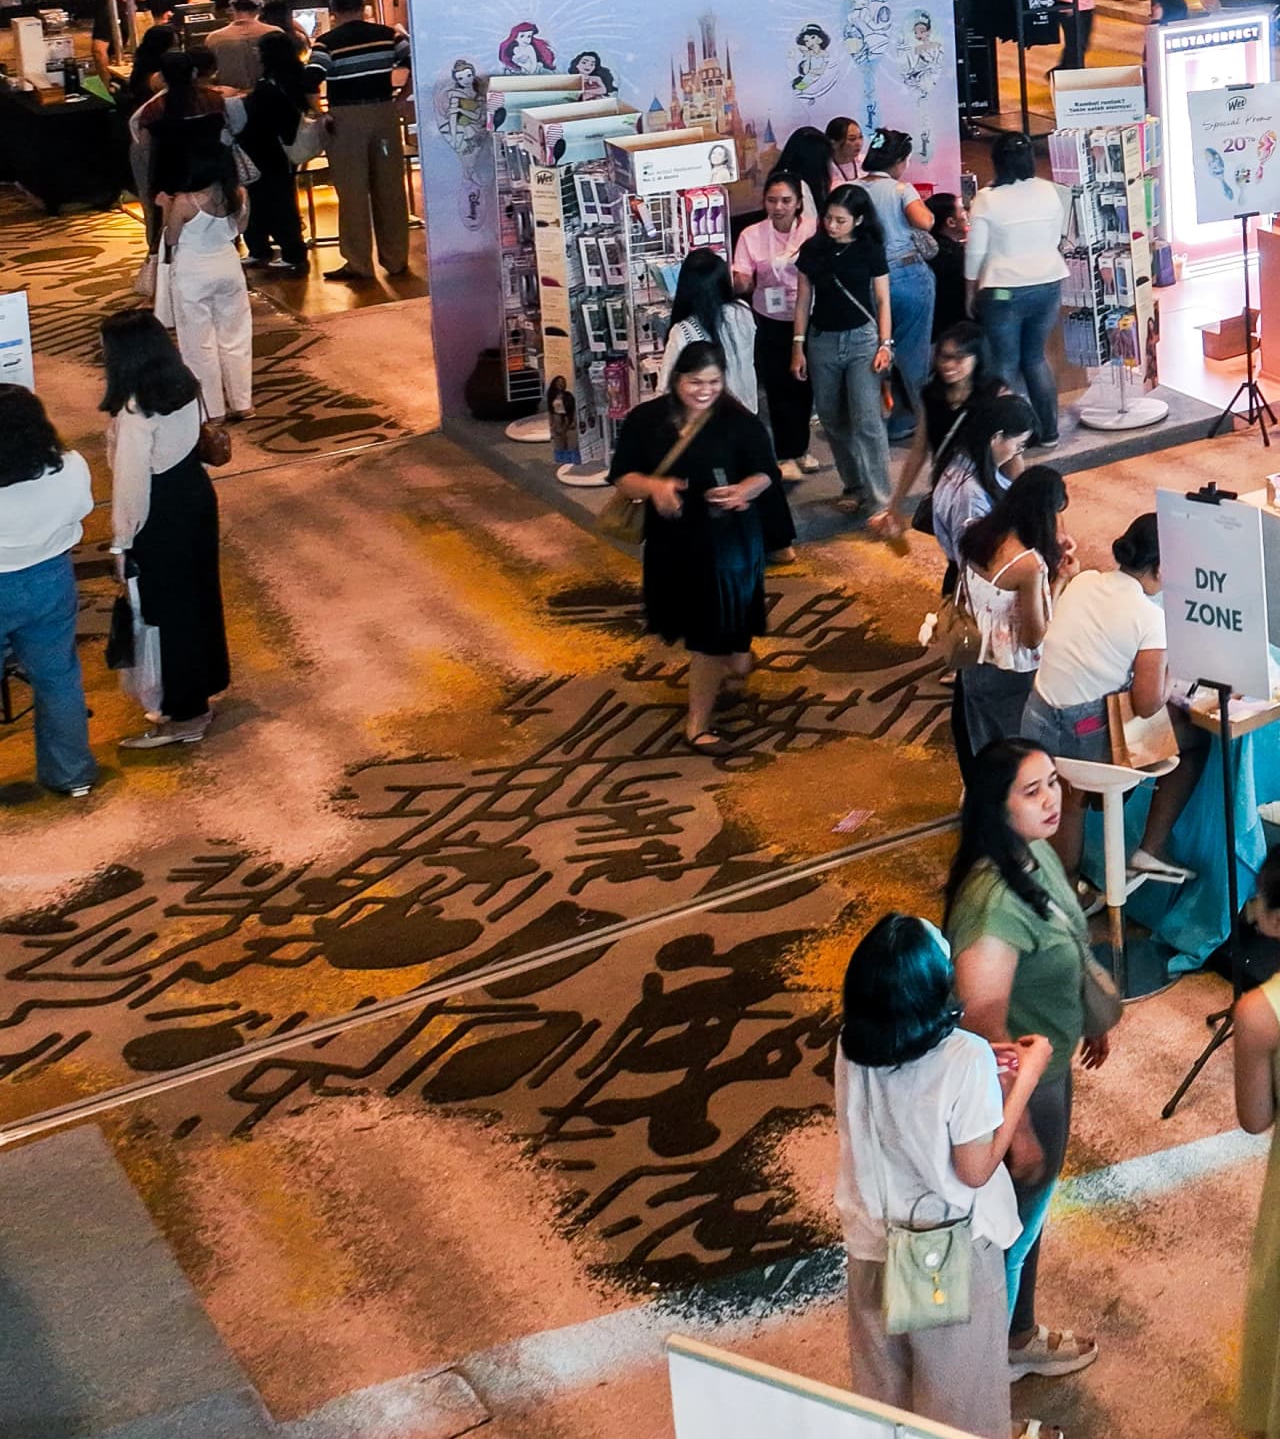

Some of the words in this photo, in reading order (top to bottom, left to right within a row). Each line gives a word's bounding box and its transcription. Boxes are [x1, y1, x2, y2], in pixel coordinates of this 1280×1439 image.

[1166, 27, 1259, 50] INSTAPERFECT
[1195, 567, 1227, 593] DIY
[1184, 599, 1243, 632] ZONE
